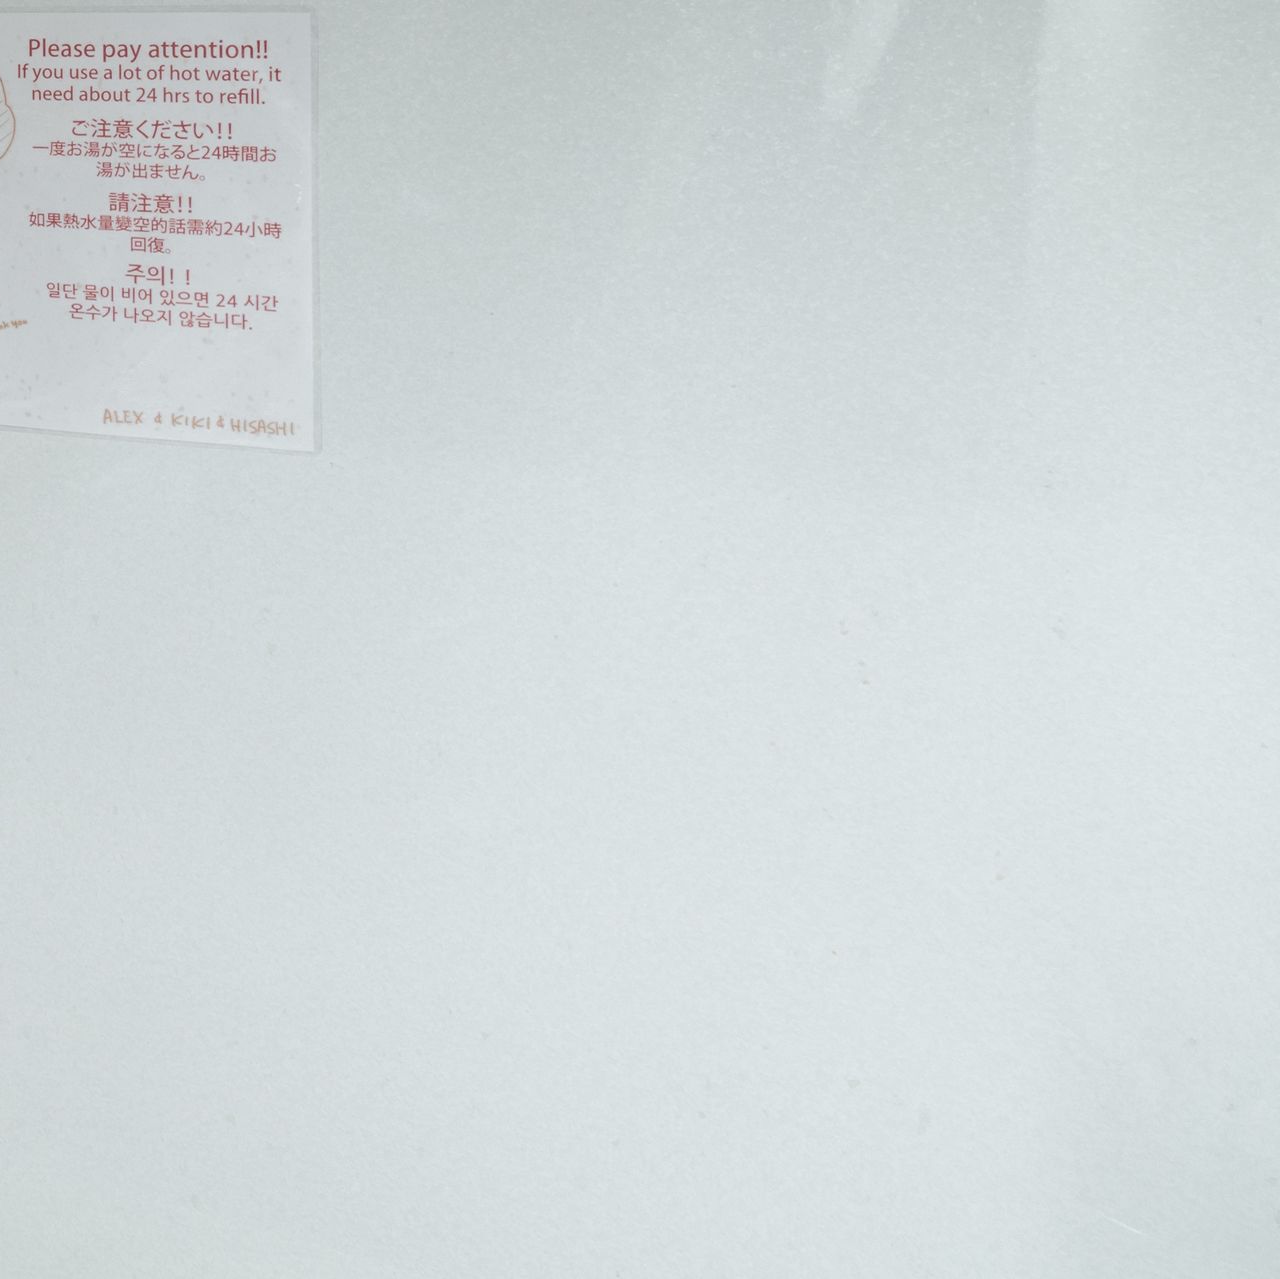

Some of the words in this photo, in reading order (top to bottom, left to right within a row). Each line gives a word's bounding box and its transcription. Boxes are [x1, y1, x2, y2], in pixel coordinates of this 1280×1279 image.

[28, 39, 96, 59] Please
[103, 41, 142, 62] pay
[148, 39, 269, 60] attention!!
[17, 64, 29, 79] If
[32, 67, 64, 82] you
[69, 66, 98, 80] use
[104, 68, 113, 80] a
[118, 65, 142, 80] lot
[147, 65, 165, 81] of
[170, 65, 200, 81] hot
[205, 66, 263, 84] water,
[269, 66, 282, 82] it
[32, 86, 74, 102] need
[79, 87, 130, 103] about
[136, 88, 158, 103] 24
[162, 88, 190, 104] hrs
[195, 89, 214, 104] to
[219, 89, 266, 105] refill.
[71, 119, 233, 140] ご注意ください!!
[32, 141, 277, 163] 一度お湯が空になると24時間お
[96, 162, 207, 182] 湯が出ません。
[108, 192, 193, 214] 請注意!!
[28, 211, 282, 239] 如果熱水量變空的話需約24小時
[130, 236, 172, 254] 回復。
[46, 282, 78, 299] 일단
[83, 283, 115, 302] 물이
[121, 286, 153, 304] 비어
[159, 289, 210, 308] 있으면
[215, 293, 238, 308] 24
[244, 295, 279, 312] 시간
[69, 303, 118, 321] 온수가
[123, 307, 173, 326] 나오지
[179, 310, 253, 330] 않습니다.
[102, 408, 144, 425] ALEX
[171, 413, 211, 430] KIKI
[230, 418, 296, 436] HISASHI
